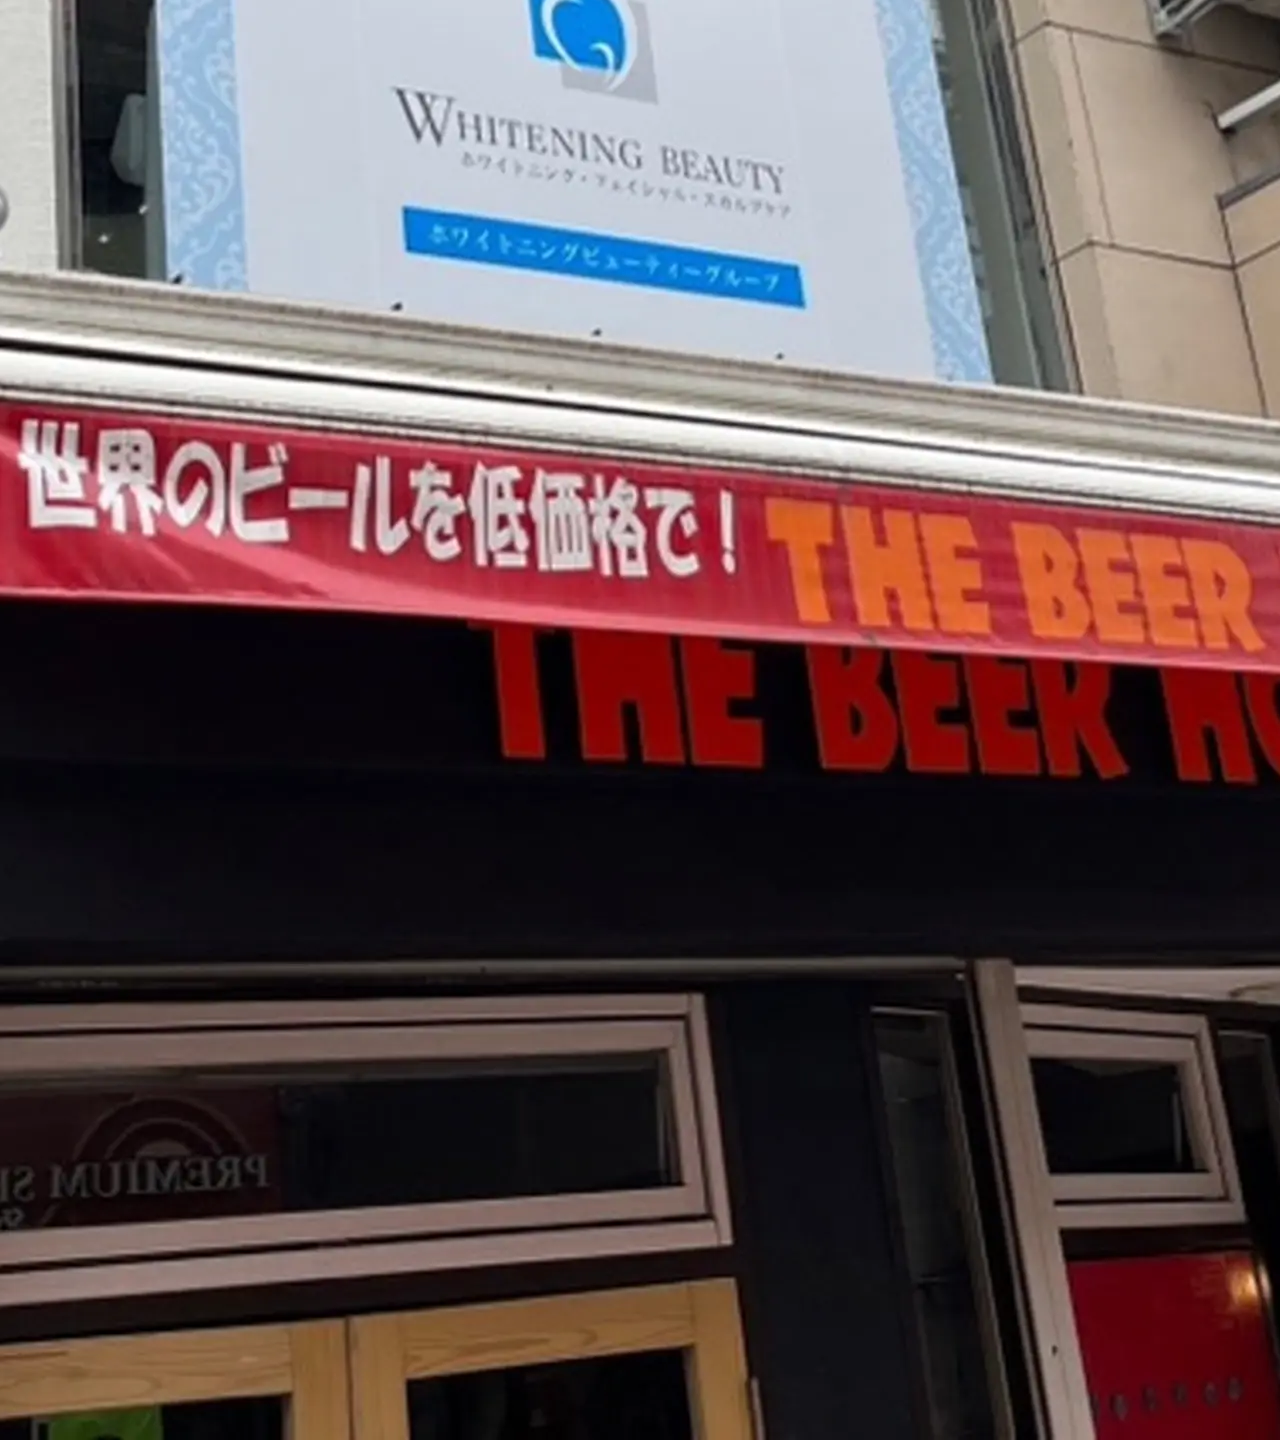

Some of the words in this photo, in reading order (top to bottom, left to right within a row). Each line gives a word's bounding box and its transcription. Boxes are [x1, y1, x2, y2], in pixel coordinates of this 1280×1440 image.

[660, 144, 786, 196] BEAUTY
[765, 498, 992, 637] THE
[1011, 521, 1266, 654] BEER
[470, 621, 765, 769] THE
[806, 644, 1129, 780] BEER
